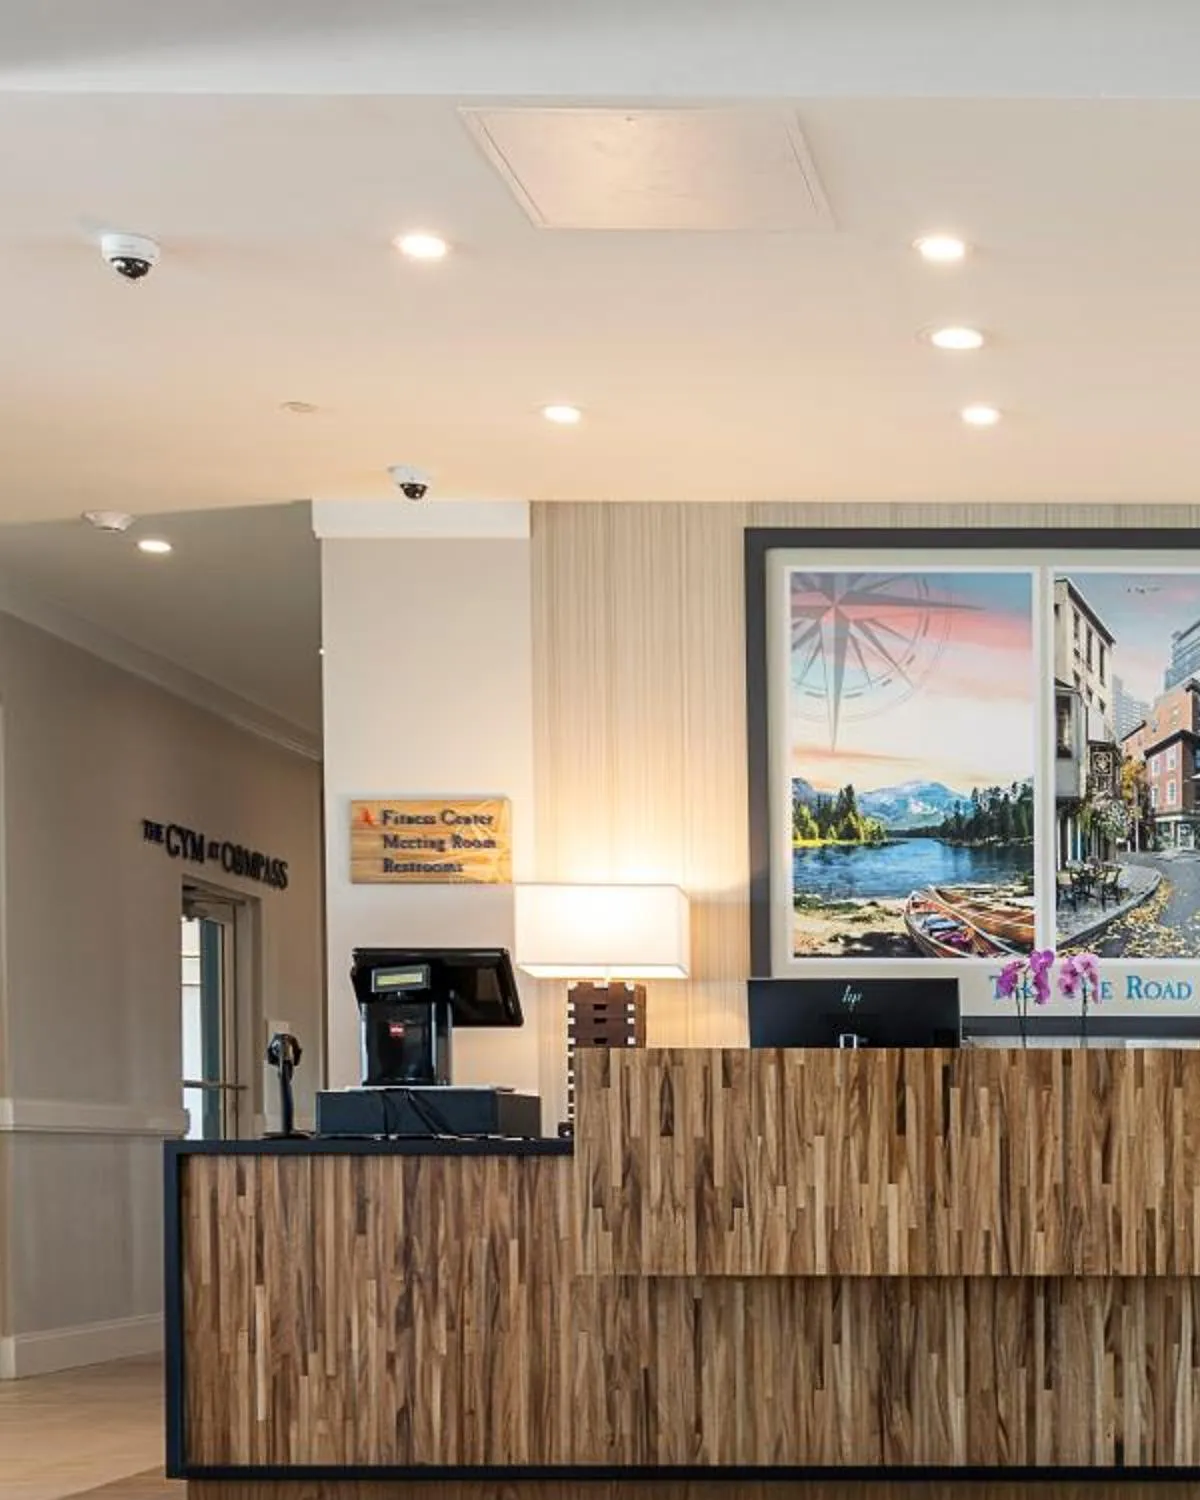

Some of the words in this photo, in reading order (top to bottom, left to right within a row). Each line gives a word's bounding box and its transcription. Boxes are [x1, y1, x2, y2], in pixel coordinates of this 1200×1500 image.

[383, 809, 437, 826] Fitness
[441, 809, 494, 826] Center
[383, 832, 446, 852] Meeting
[452, 832, 497, 849] Room
[142, 820, 164, 844] THE
[166, 824, 205, 864] GYM
[221, 841, 289, 890] COMPASS
[383, 857, 464, 873] Restrooms
